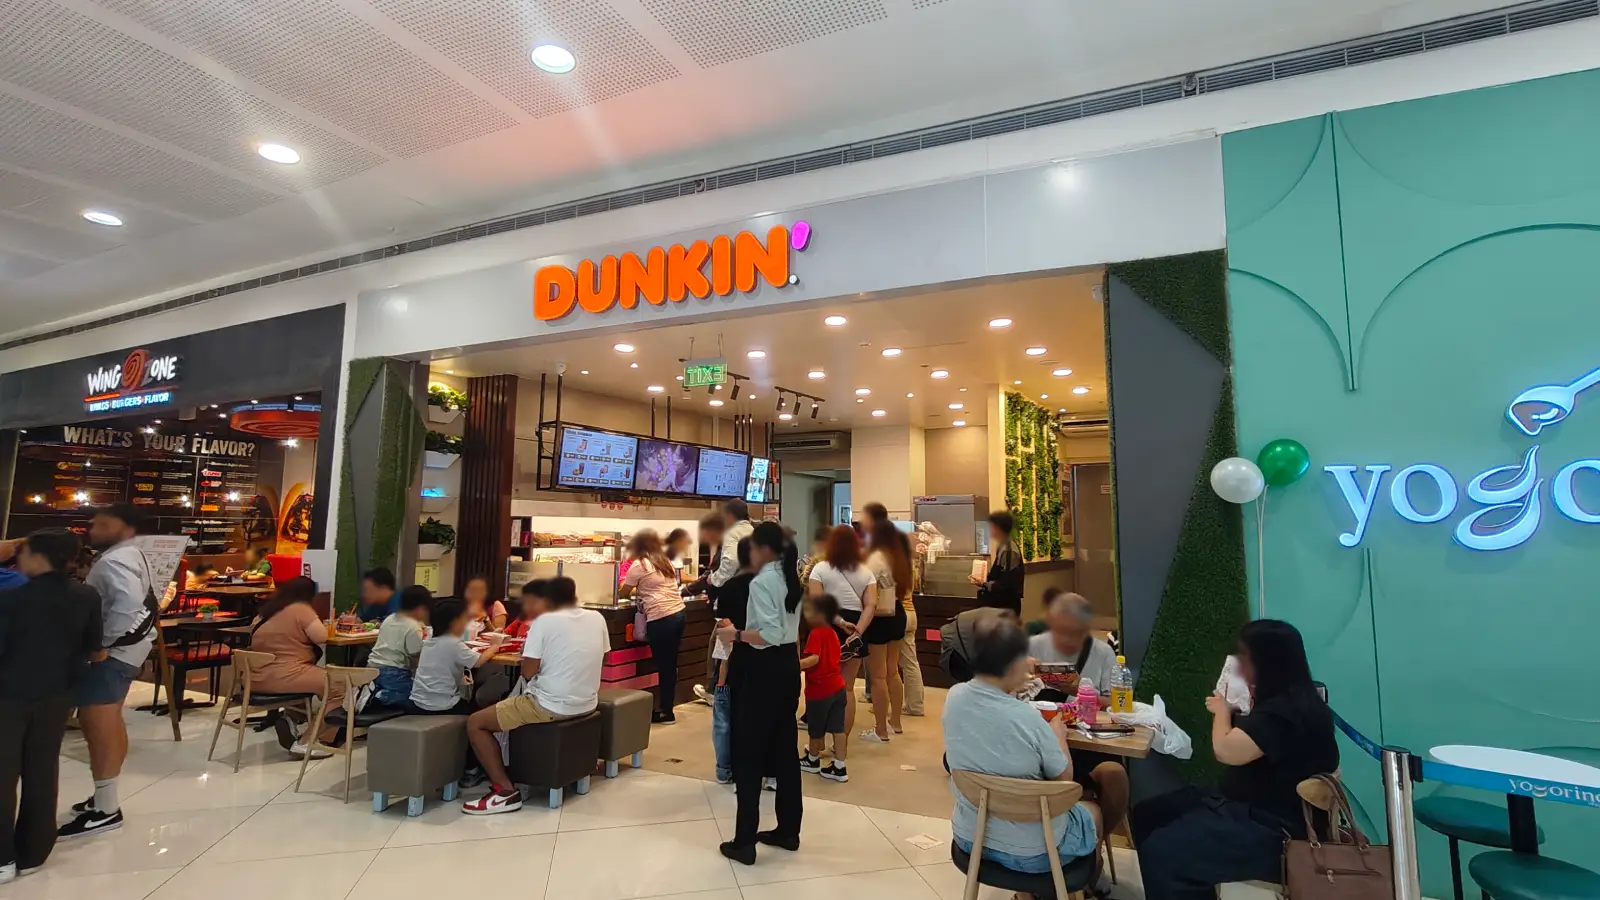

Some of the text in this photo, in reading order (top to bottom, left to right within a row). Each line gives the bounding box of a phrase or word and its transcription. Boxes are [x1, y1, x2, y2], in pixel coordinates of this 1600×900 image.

[533, 220, 812, 321] DUNKIN'
[87, 355, 178, 395] WING ZONE
[144, 392, 170, 404] FLAVOR
[63, 425, 256, 457] WHAT'S YOUR FLAVOR?
